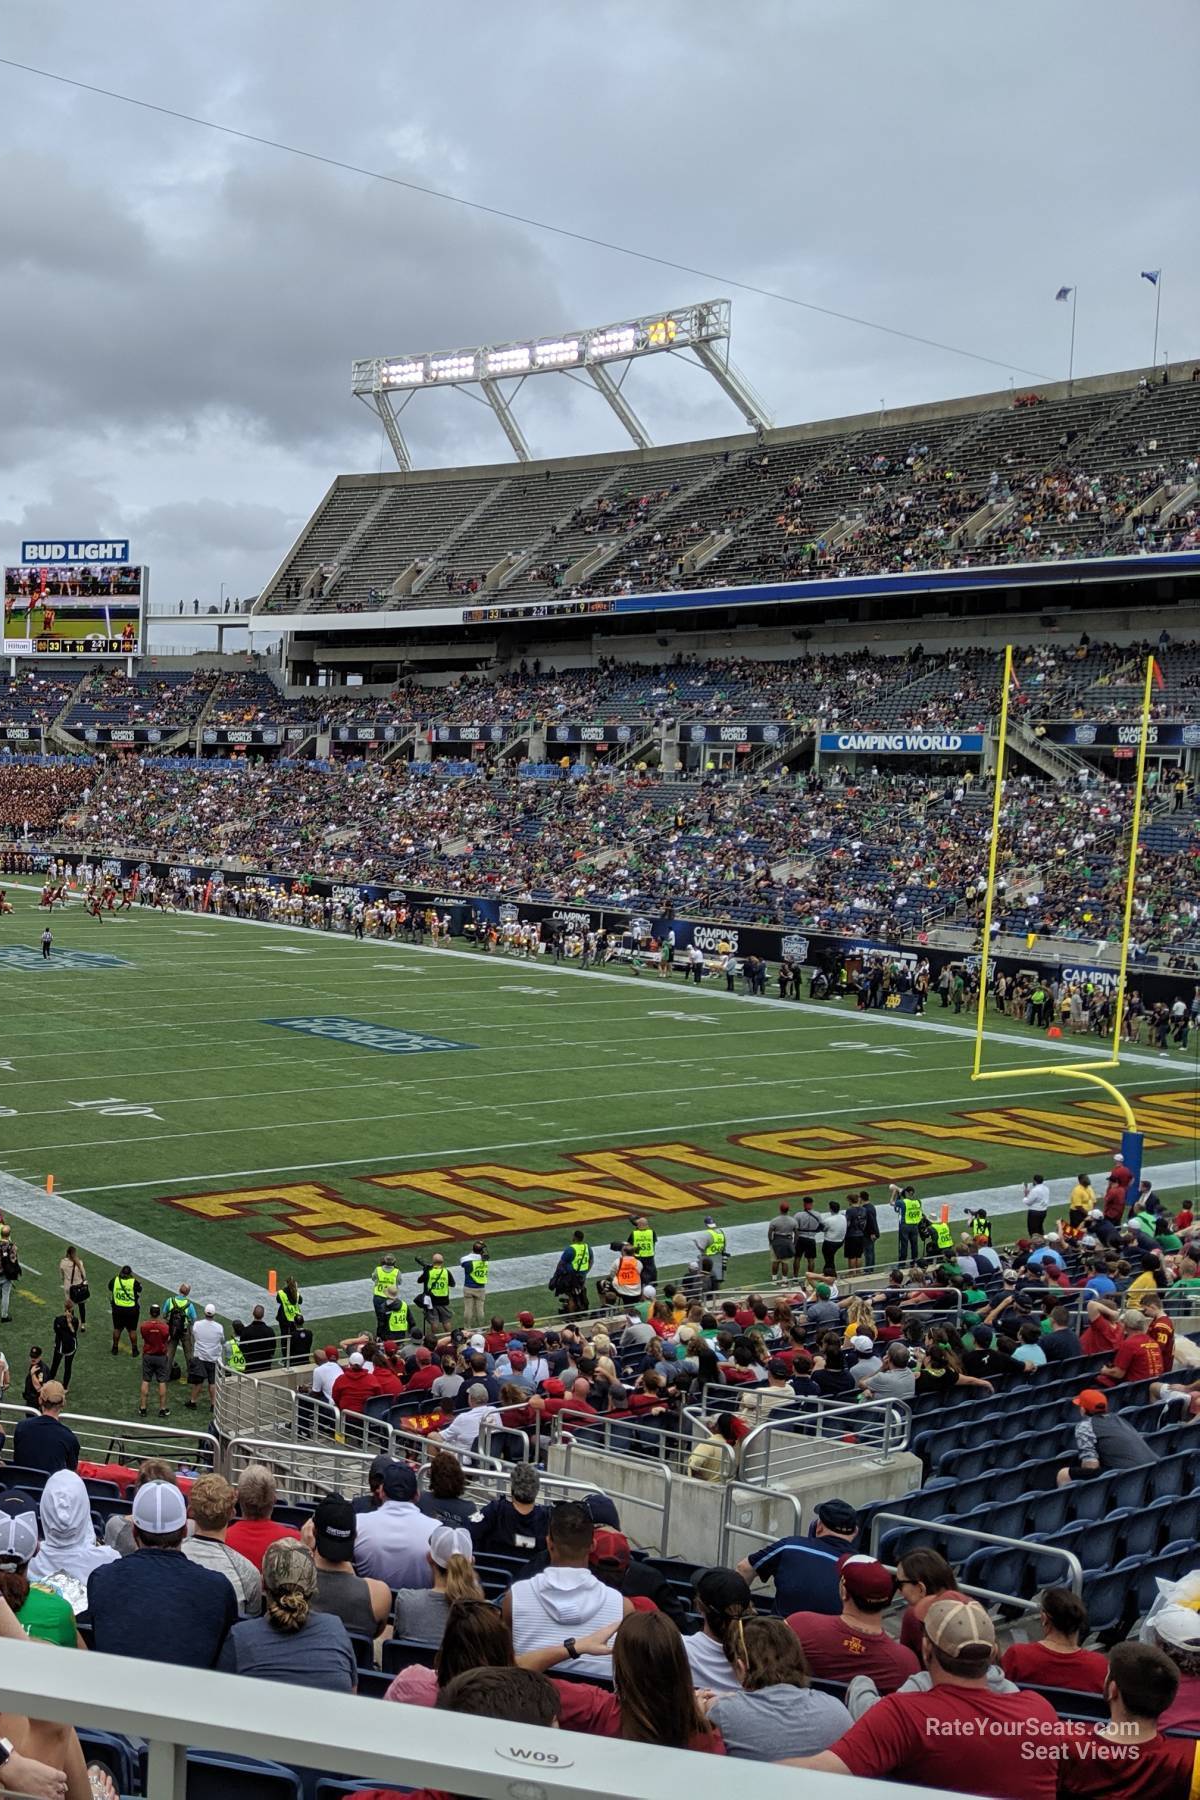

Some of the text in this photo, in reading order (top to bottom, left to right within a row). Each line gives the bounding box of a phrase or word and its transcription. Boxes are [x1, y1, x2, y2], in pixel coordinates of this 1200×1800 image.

[25, 543, 125, 560] BUD LIGHT
[489, 609, 499, 619] 33
[532, 606, 548, 616] 2:21
[579, 602, 585, 613] 9
[49, 642, 60, 651] 33
[91, 640, 105, 648] 2:21
[112, 642, 118, 650] 9
[720, 726, 747, 734] CAMPING
[720, 733, 747, 741] WORLD
[837, 735, 962, 751] CAMPING WORLD
[332, 885, 360, 896] CAMPING
[552, 910, 591, 924] CAMPING
[693, 926, 739, 941] CAMPING
[67, 1096, 158, 1118] 10
[153, 1126, 987, 1261] STATE
[509, 1748, 559, 1764] W09
